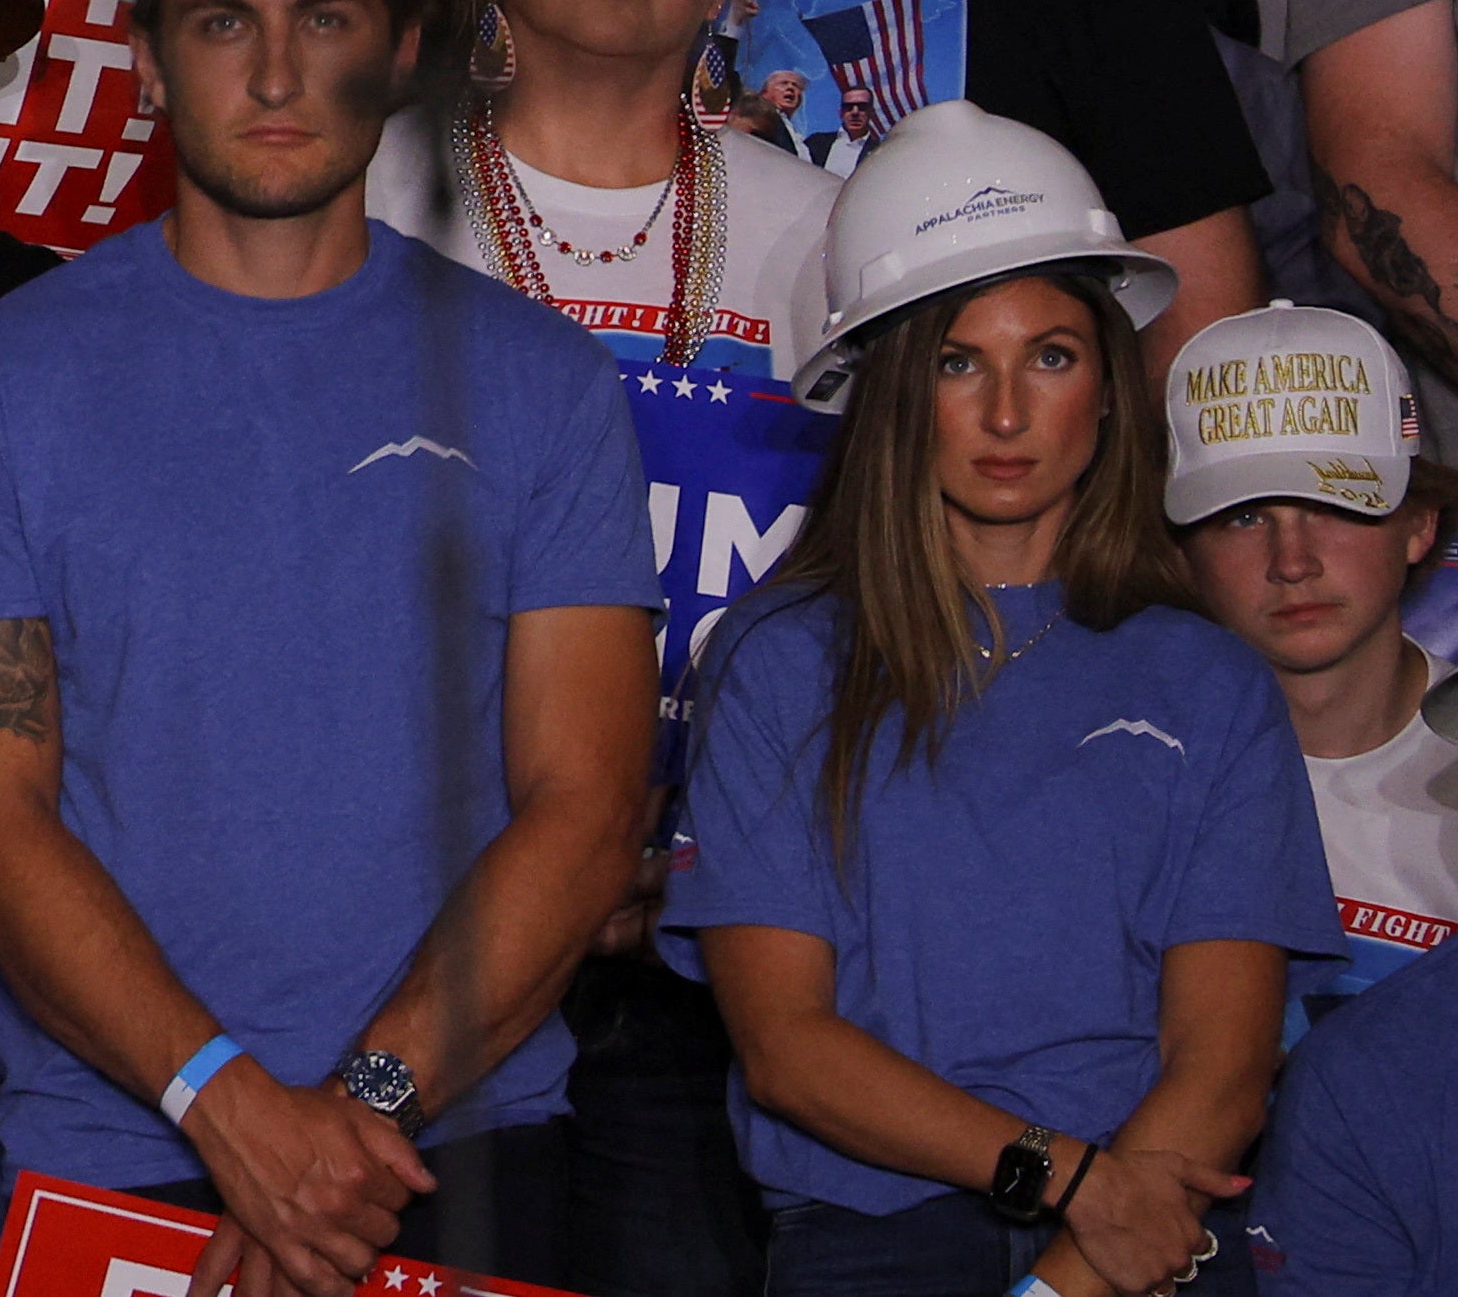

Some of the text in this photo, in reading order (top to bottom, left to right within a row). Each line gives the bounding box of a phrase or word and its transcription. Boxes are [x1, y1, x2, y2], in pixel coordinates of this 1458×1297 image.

[915, 192, 1044, 236] APPALACHIA ENERGY
[966, 205, 1027, 223] PARTNERS
[1185, 353, 1371, 406] MAKE AMERICA
[1198, 395, 1360, 445] GREAT AGAIN
